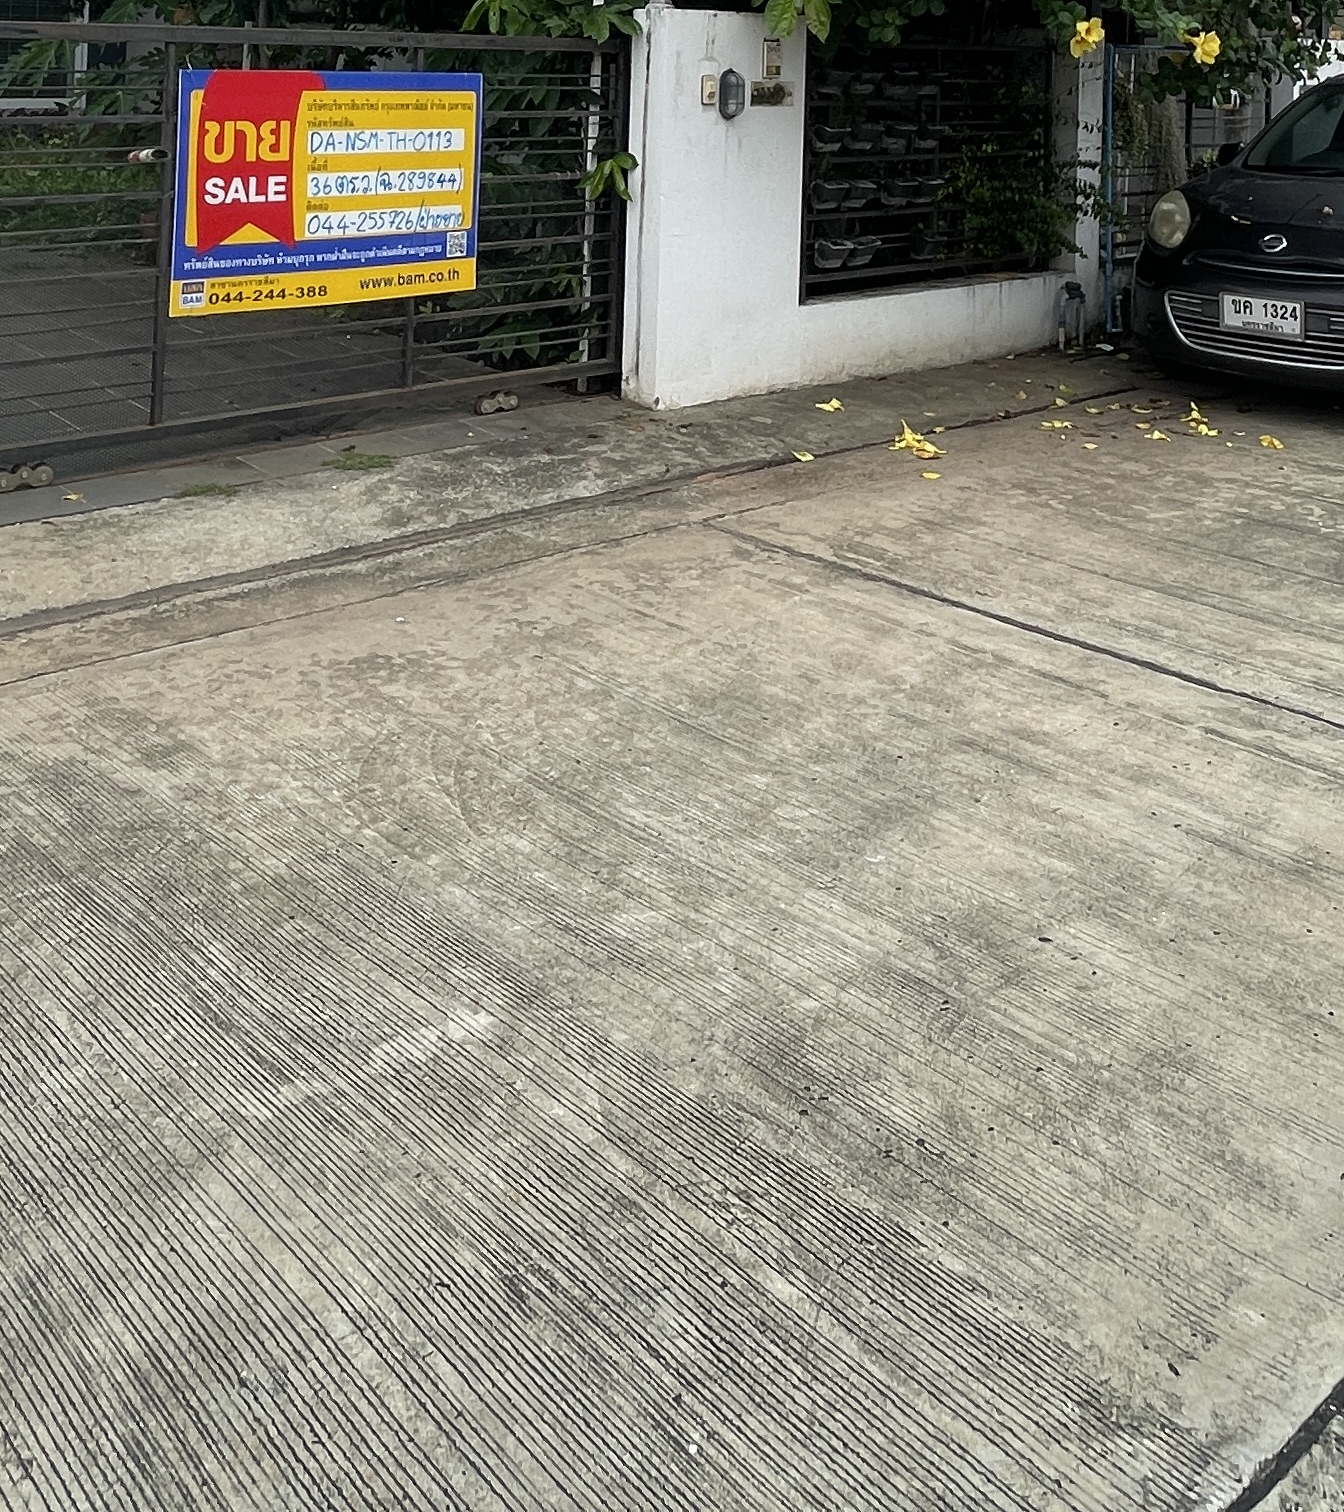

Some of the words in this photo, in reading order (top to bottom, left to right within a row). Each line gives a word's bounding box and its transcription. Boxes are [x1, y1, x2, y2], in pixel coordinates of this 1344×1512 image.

[204, 120, 291, 163] ขาย
[204, 175, 287, 205] SALE
[360, 268, 459, 290] www.bam.co.th
[182, 295, 203, 305] BAM
[209, 285, 328, 305] 044-244-388
[1262, 302, 1299, 322] 1324
